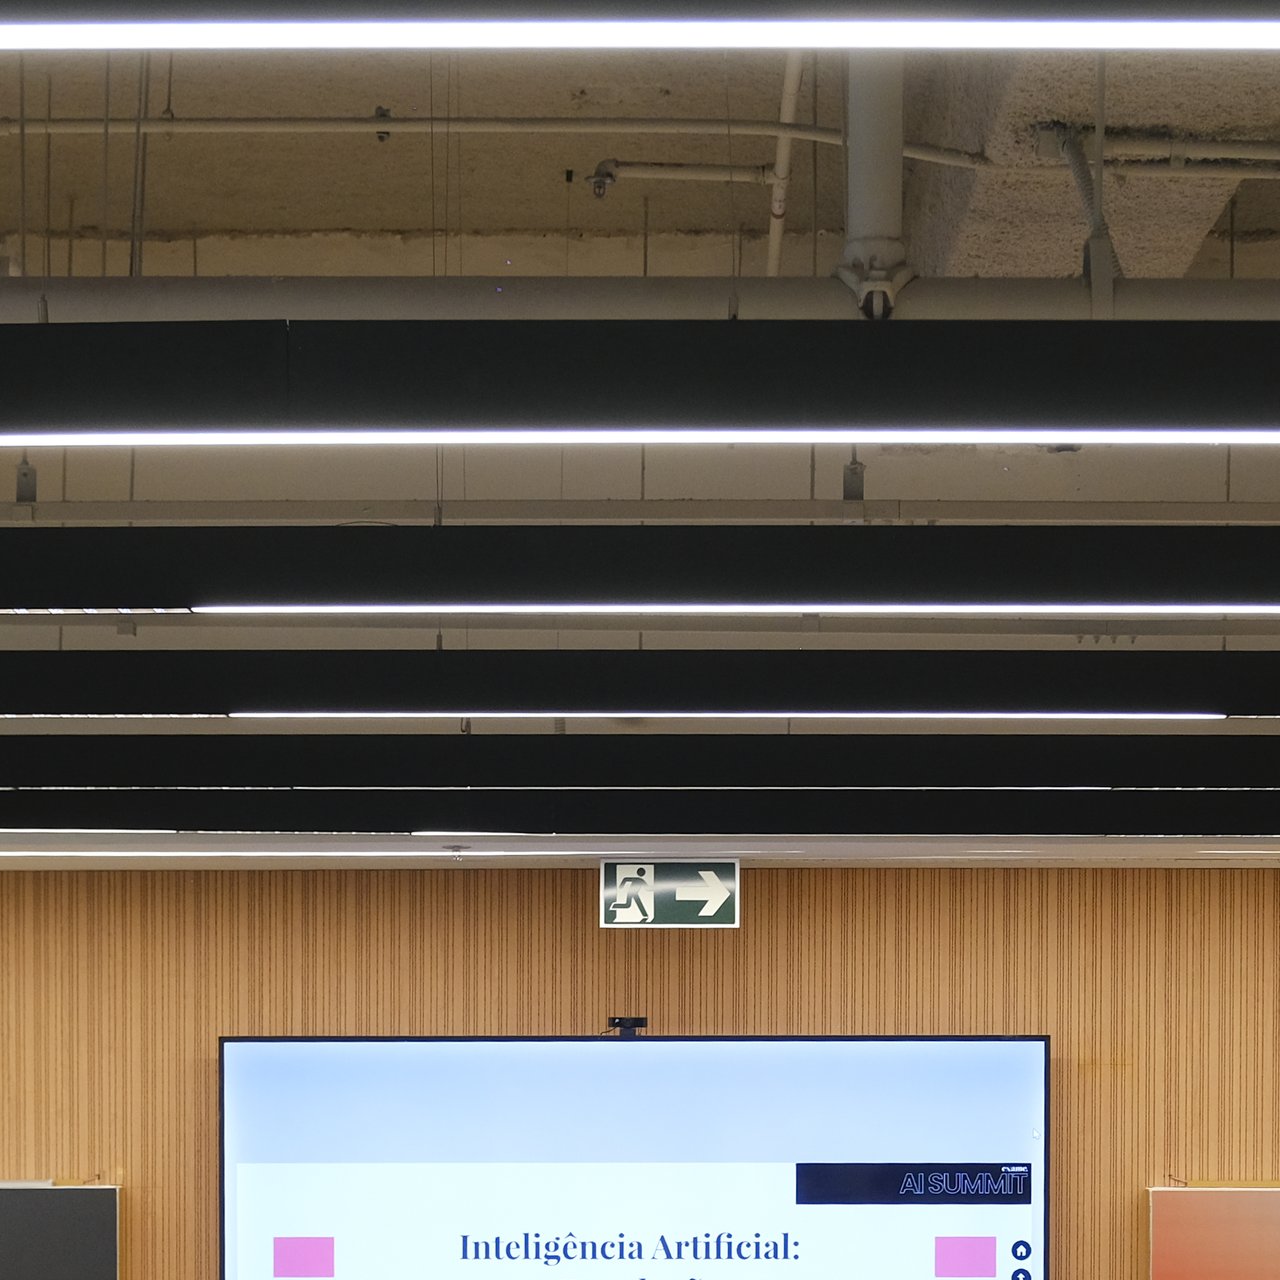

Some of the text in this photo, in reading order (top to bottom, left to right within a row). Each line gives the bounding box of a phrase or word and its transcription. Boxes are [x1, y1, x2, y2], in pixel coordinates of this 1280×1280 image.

[900, 1173, 1028, 1194] AI SUMMIT
[460, 1231, 800, 1266] Inteligência Artificial:
